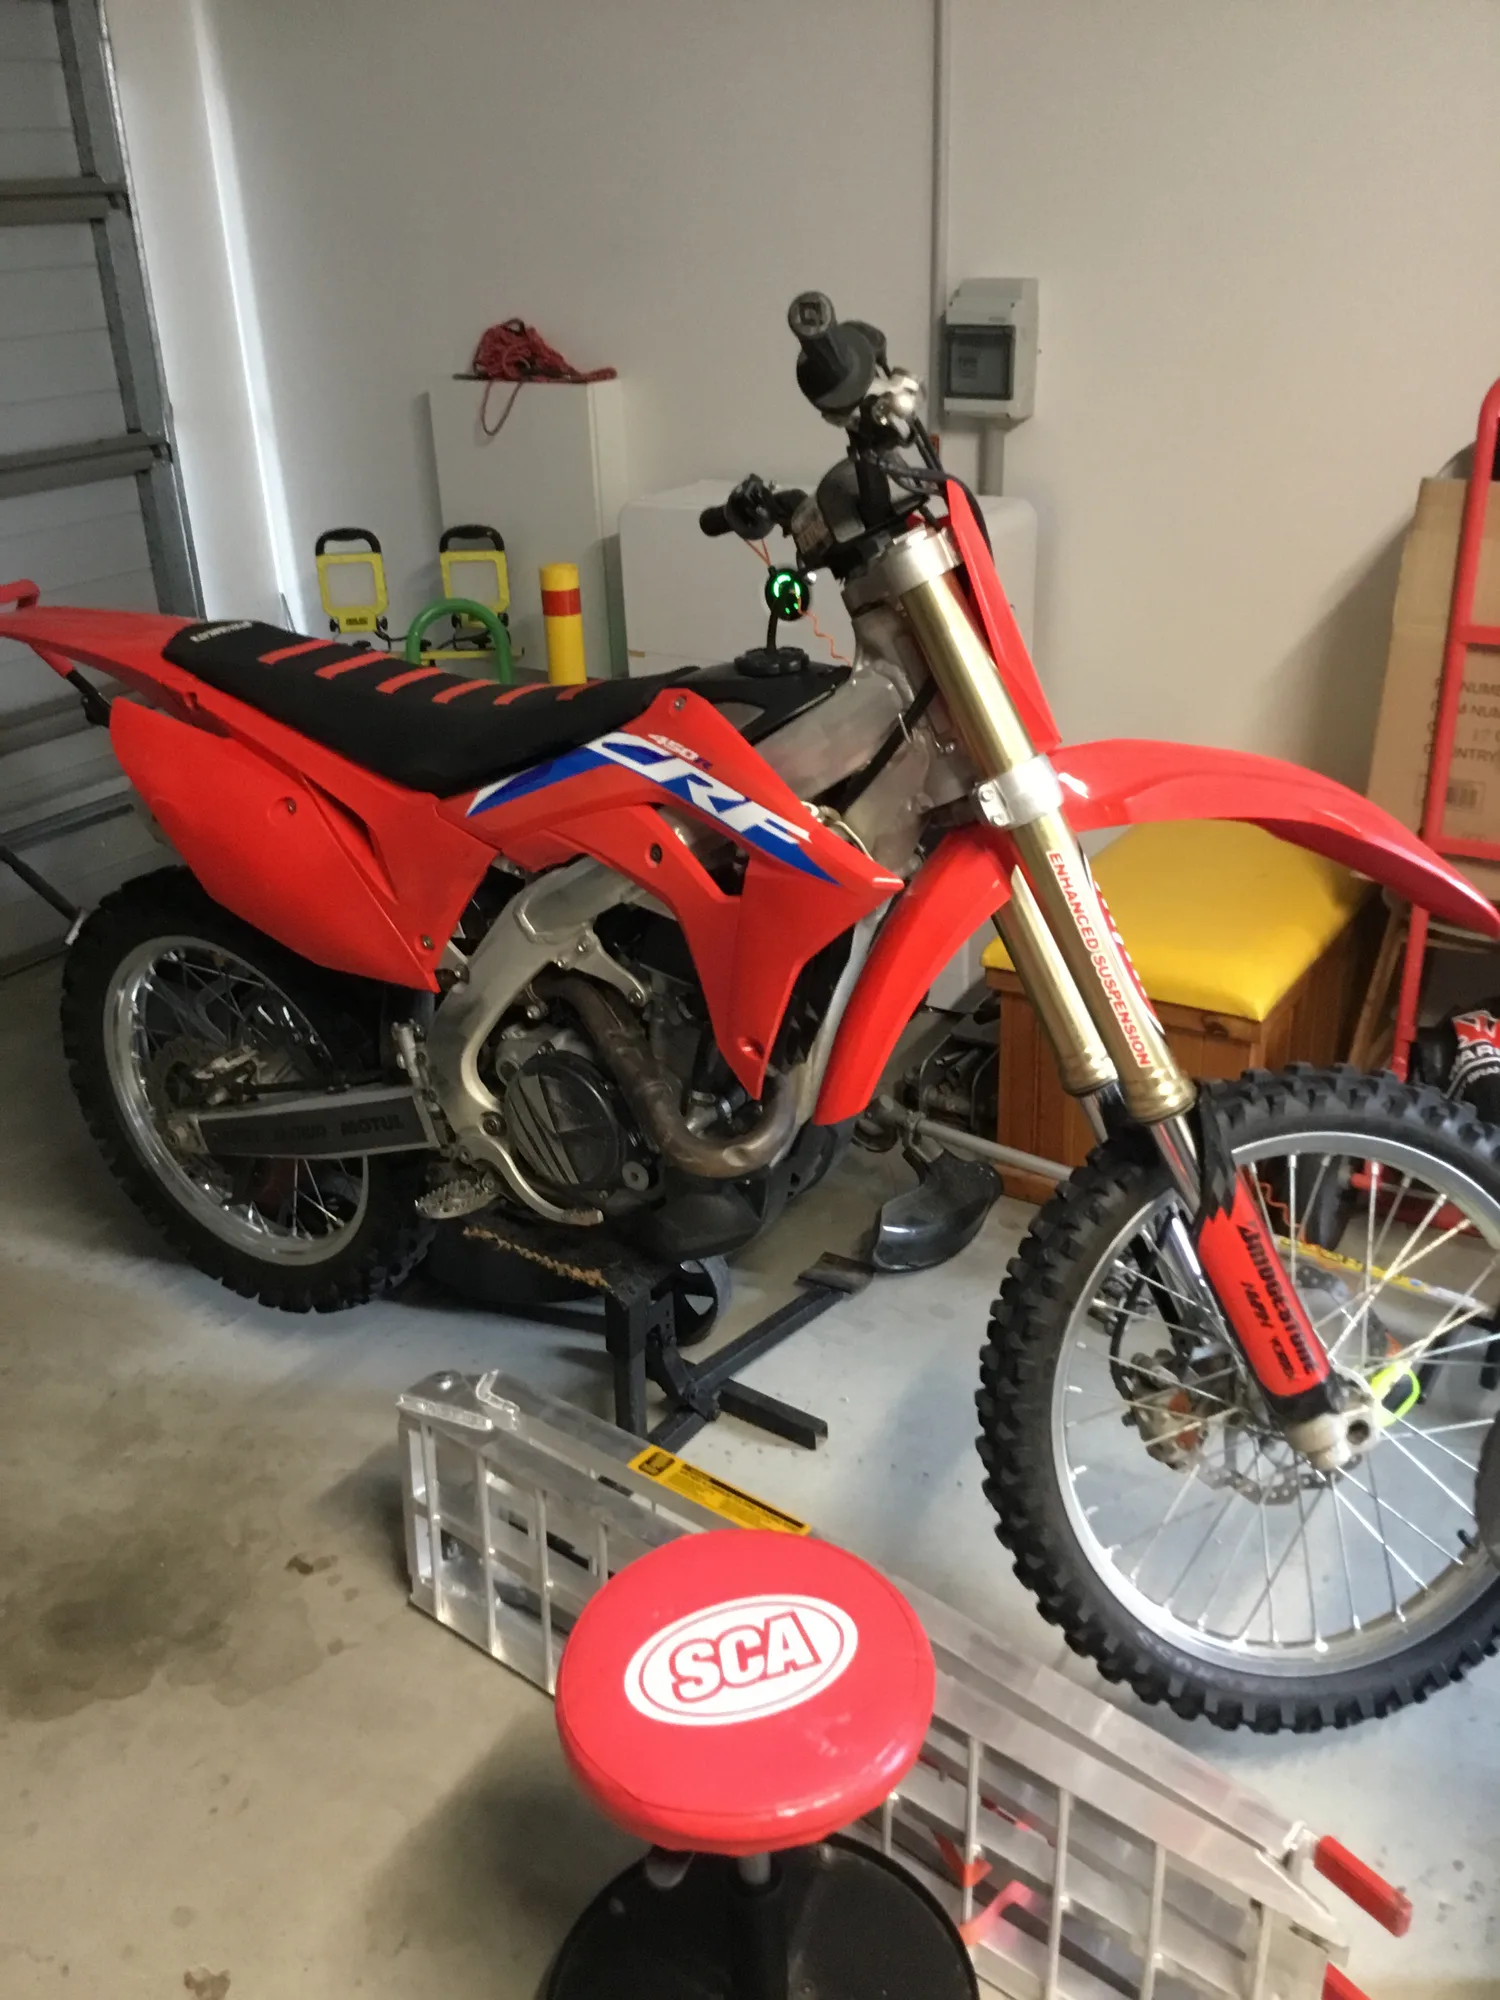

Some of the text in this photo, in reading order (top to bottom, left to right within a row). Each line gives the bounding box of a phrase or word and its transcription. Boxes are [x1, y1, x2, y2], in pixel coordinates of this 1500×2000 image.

[586, 731, 813, 844] CRF
[1049, 851, 1151, 1067] ENHANCED SUSPENSION
[340, 1114, 406, 1138] MOTUL
[669, 1609, 822, 1703] SCA
